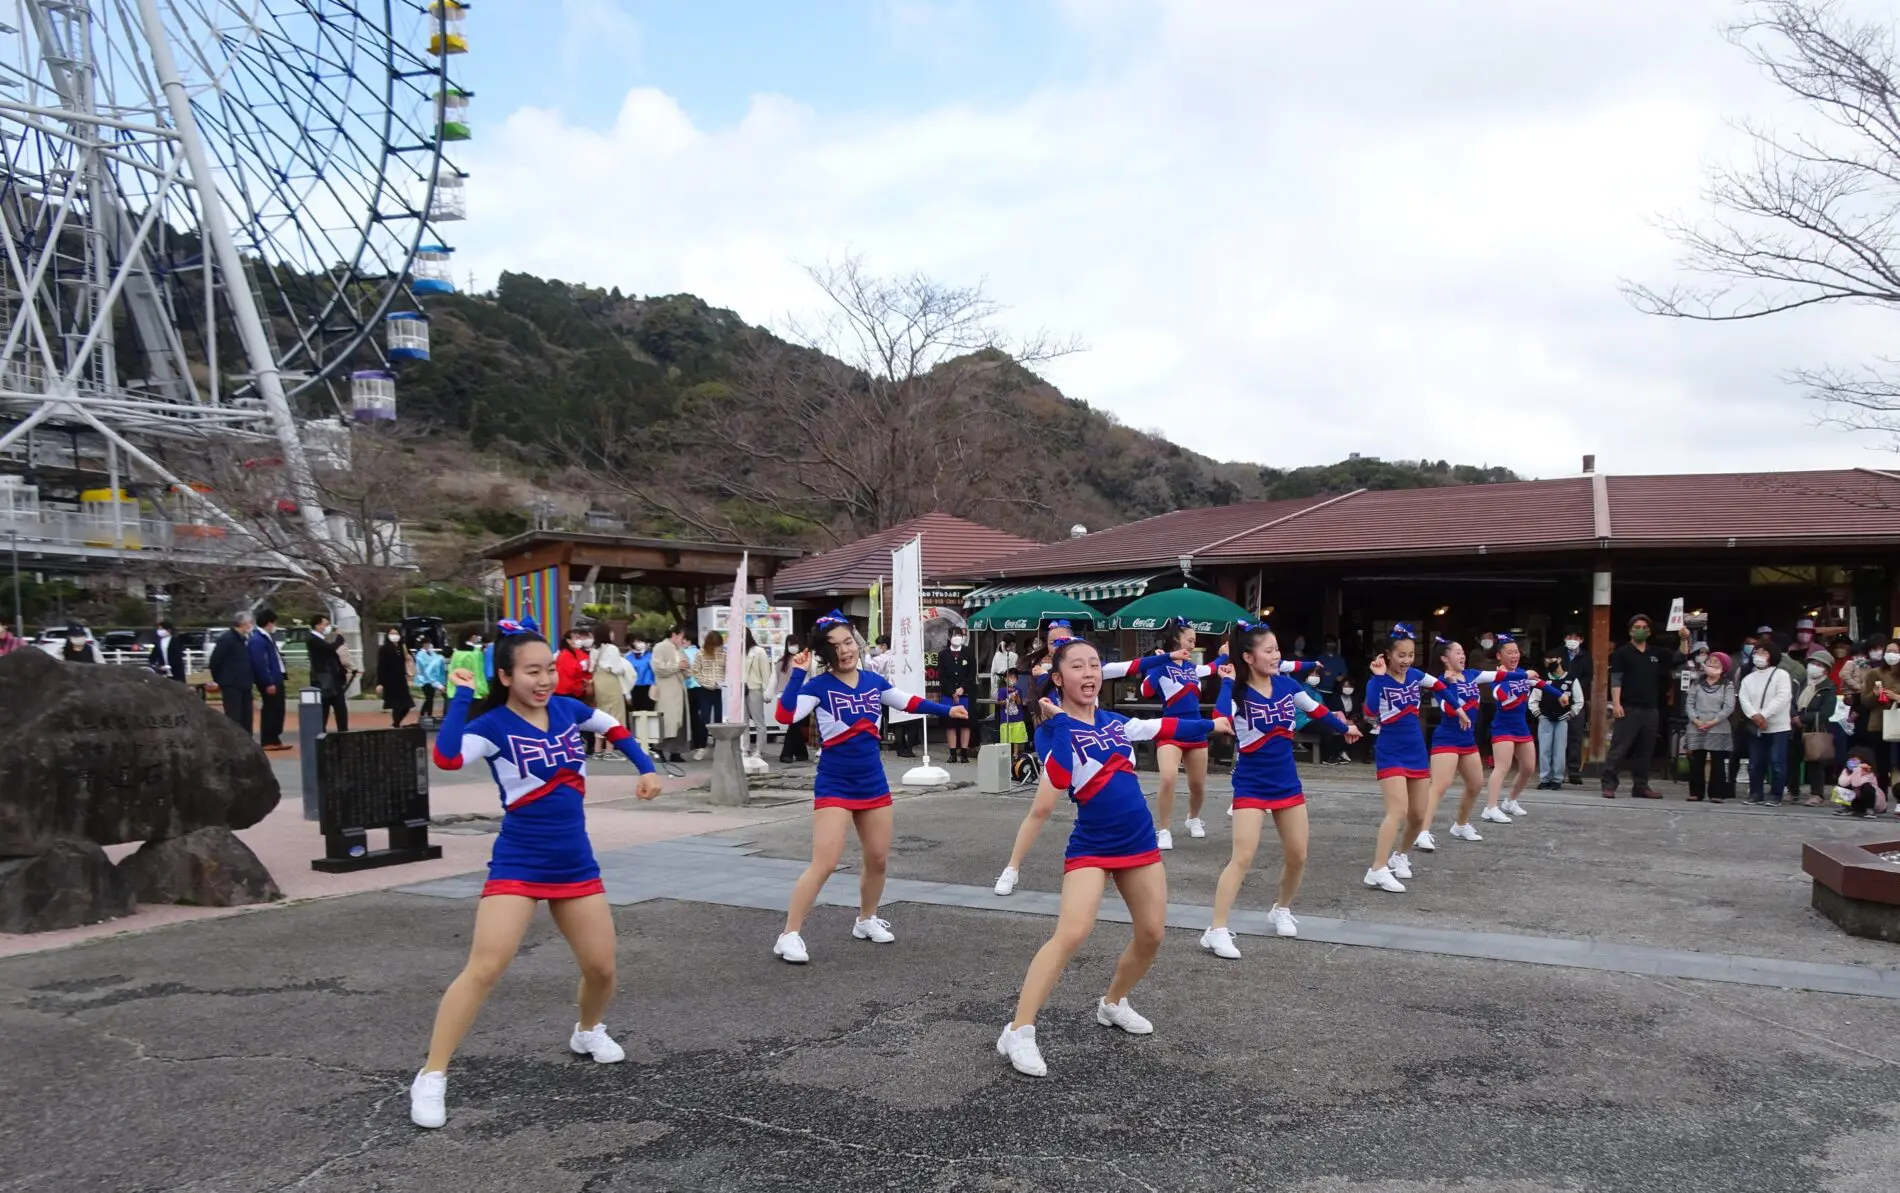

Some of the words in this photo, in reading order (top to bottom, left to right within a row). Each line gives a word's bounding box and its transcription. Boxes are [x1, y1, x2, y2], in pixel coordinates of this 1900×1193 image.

[1004, 619, 1028, 629] Coca-Cola
[1132, 617, 1156, 628] Coca-Cola
[1166, 664, 1200, 684] FHS
[827, 687, 882, 723] FHS
[1384, 680, 1421, 711] FHS
[1244, 694, 1296, 731] FHS
[507, 723, 586, 780] FHS
[1069, 719, 1134, 766] FHS
